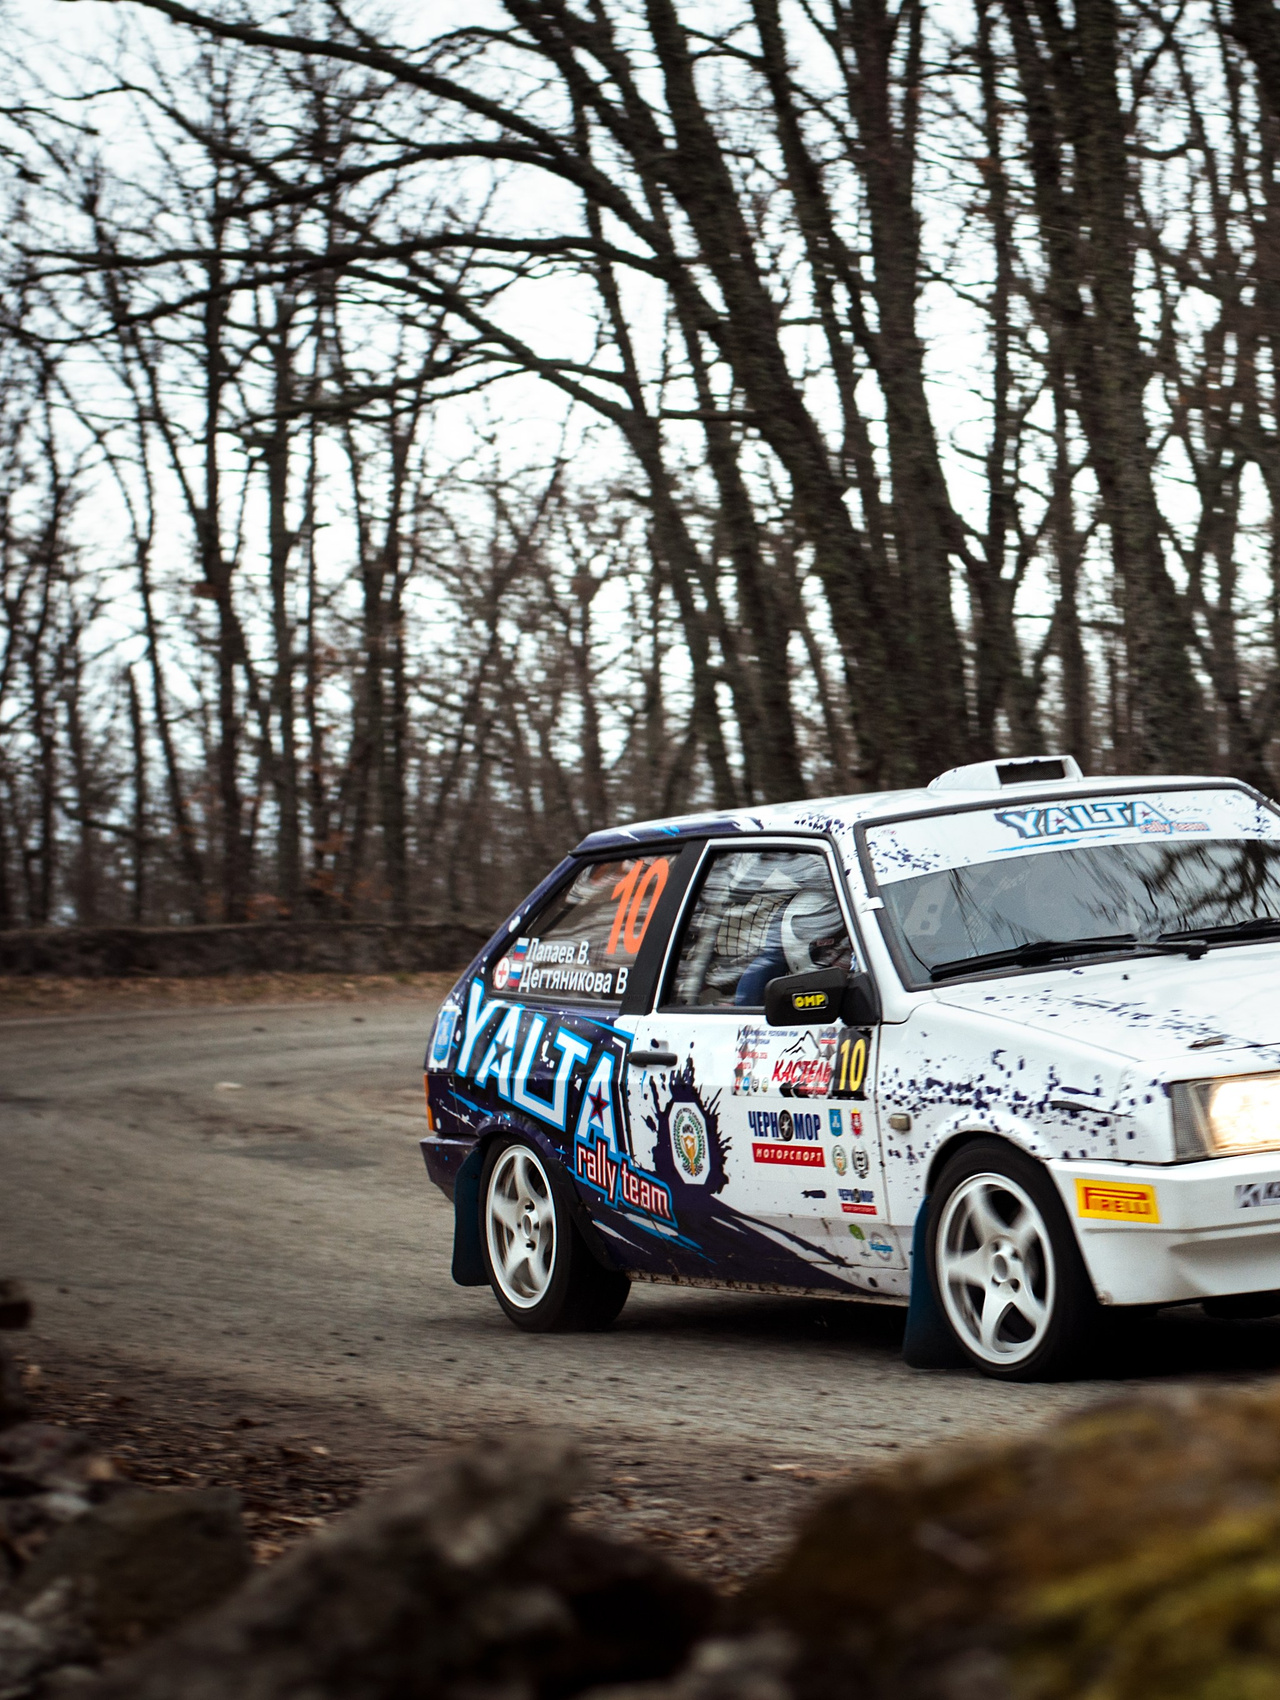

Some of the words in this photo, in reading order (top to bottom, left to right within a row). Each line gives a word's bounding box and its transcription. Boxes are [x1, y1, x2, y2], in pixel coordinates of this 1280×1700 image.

[1002, 802, 1167, 837] YALTA
[606, 858, 669, 954] 10
[525, 938, 575, 964] Лапаев
[577, 940, 590, 965] В.
[518, 962, 613, 993] Дегтяникова
[615, 967, 629, 994] В
[794, 994, 826, 1008] OMP
[455, 978, 618, 1153] YALTA
[771, 1059, 832, 1083] КАСТЕЛЬ
[839, 1038, 866, 1091] 10
[756, 1148, 822, 1162] МОТОРСПОРТ
[577, 1139, 617, 1201] rally
[621, 1160, 671, 1219] team
